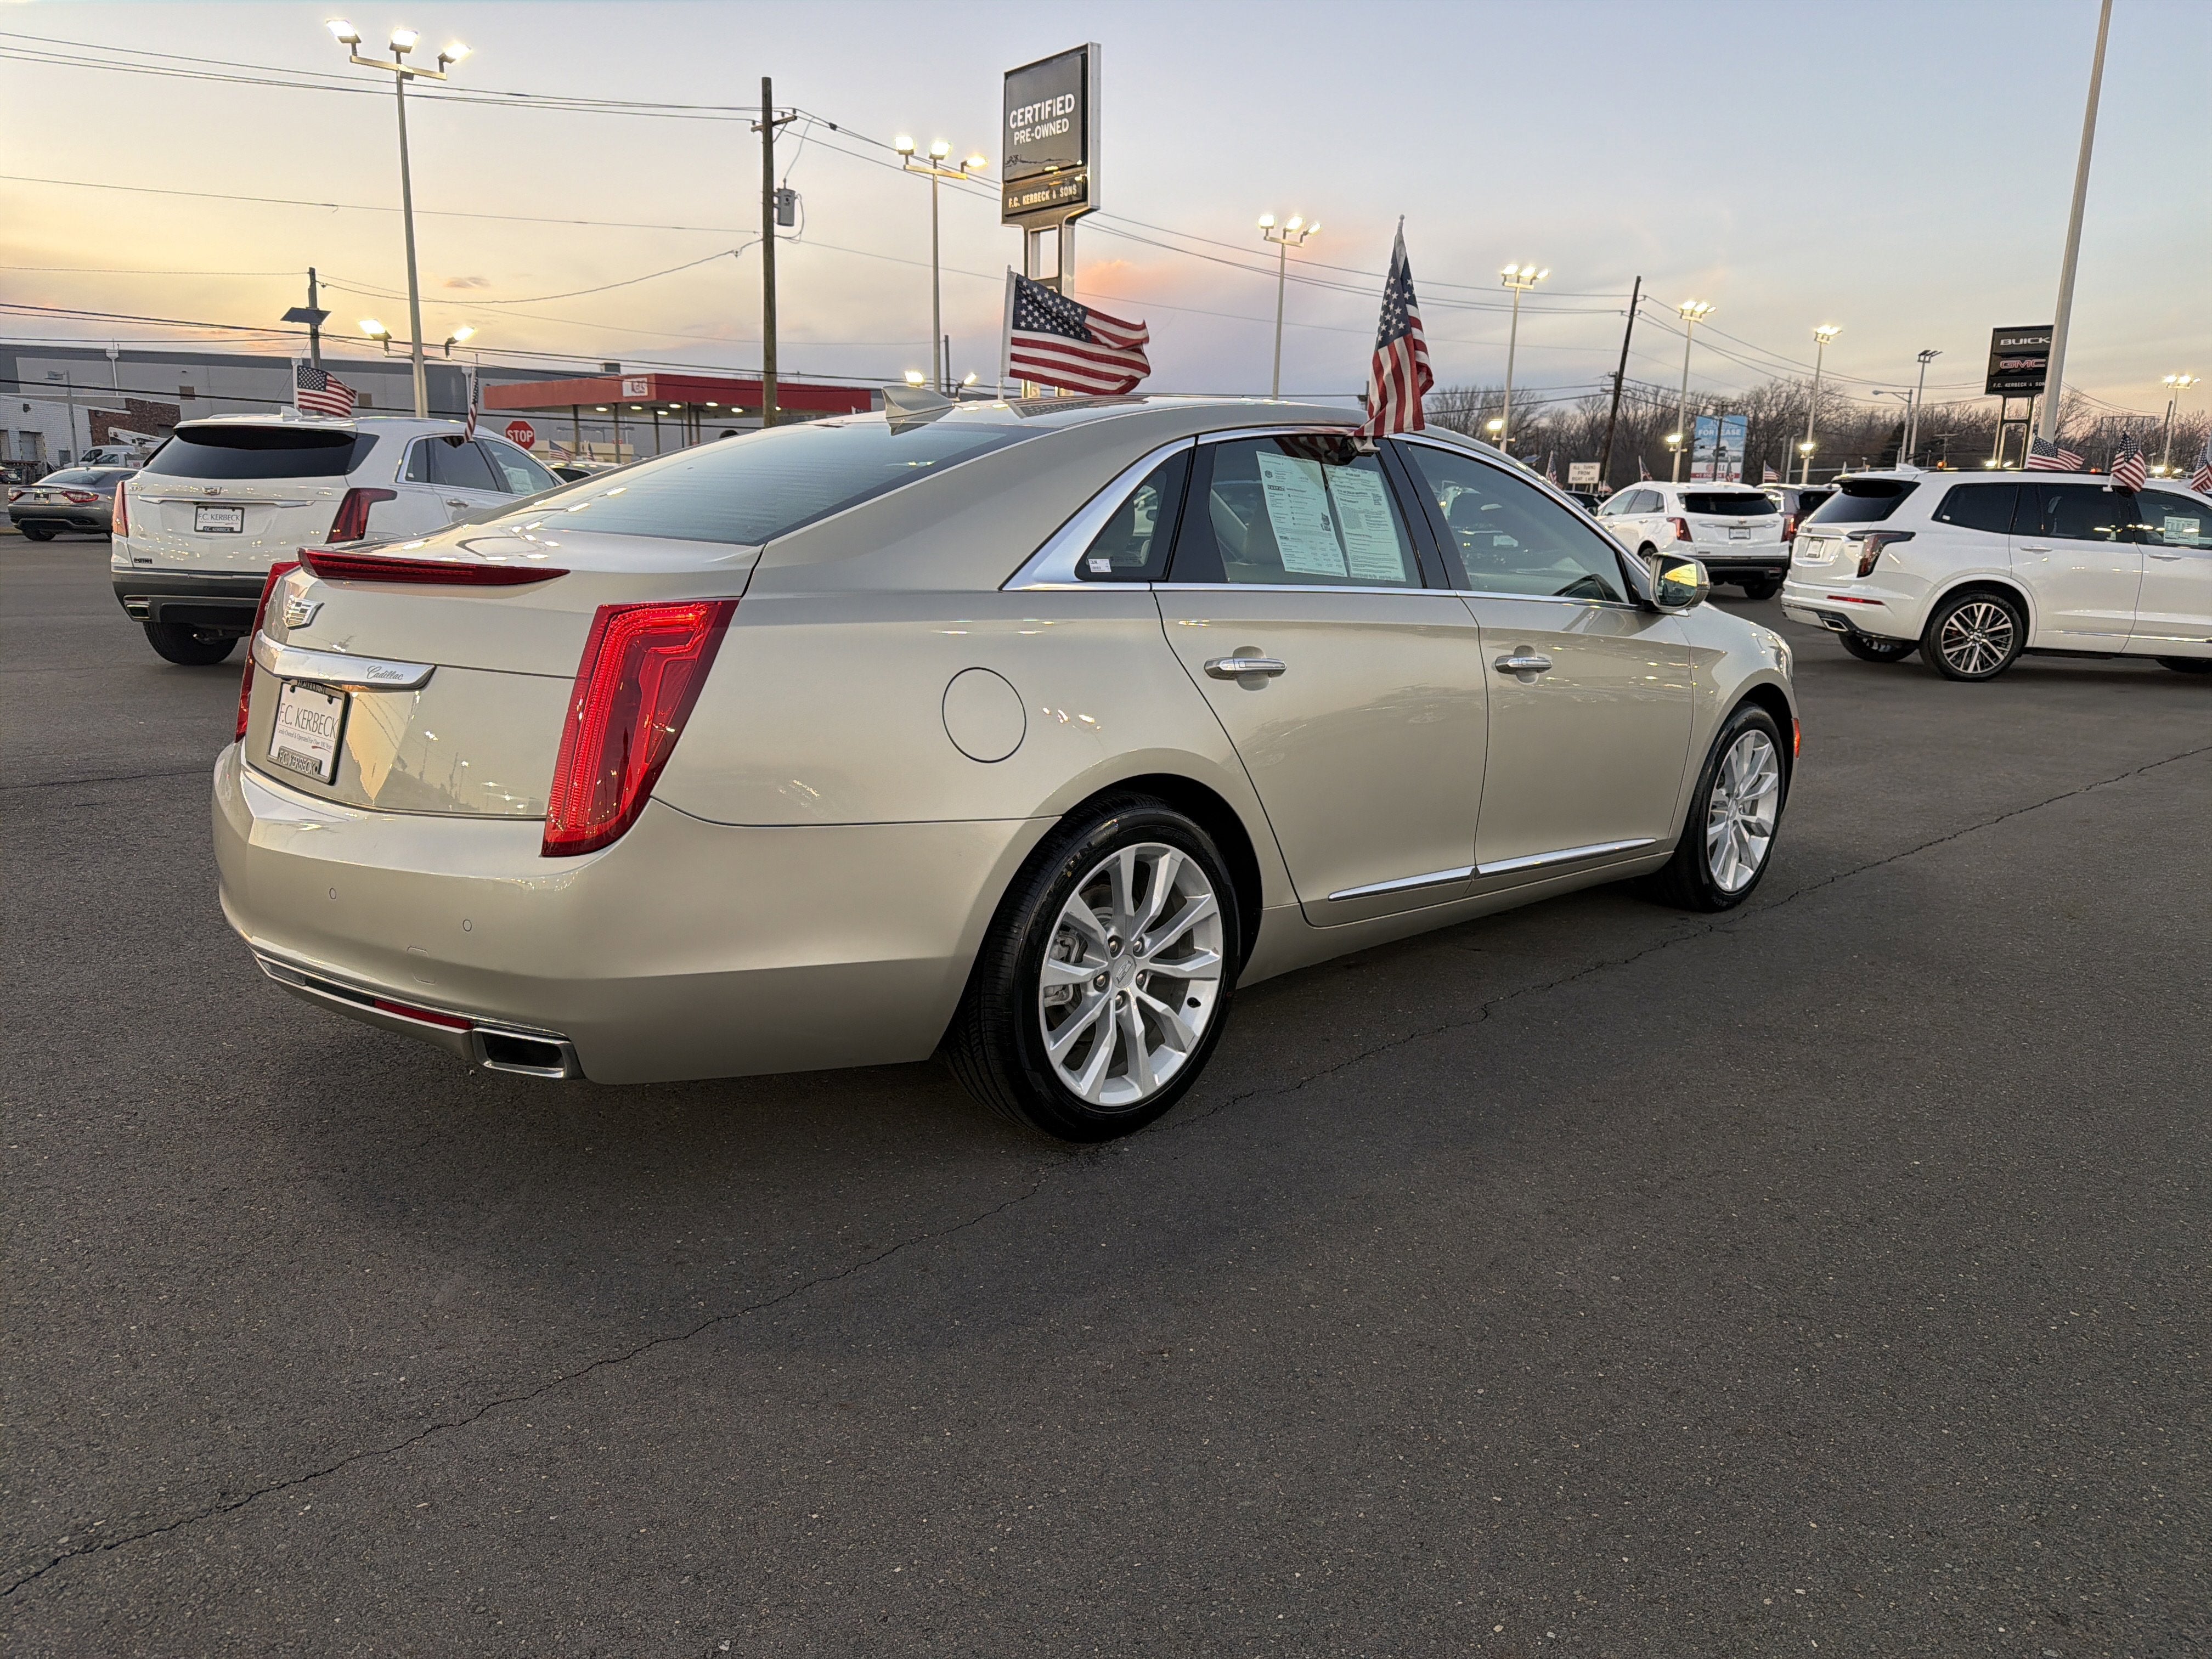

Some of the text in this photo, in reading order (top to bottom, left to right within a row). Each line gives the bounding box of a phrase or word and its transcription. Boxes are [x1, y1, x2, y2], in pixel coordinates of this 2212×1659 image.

[1009, 94, 1075, 129] CERTIFIED
[1014, 118, 1069, 145] PRE-OWNED
[1008, 196, 1020, 208] F.C.
[1022, 190, 1050, 205] KERBECK
[1059, 184, 1077, 198] SONS
[2000, 337, 2051, 346] BUICK
[2000, 359, 2046, 369] GMC
[507, 430, 533, 442] STOP
[366, 665, 404, 680] Cadillac
[278, 703, 339, 739] F.C. KERBECK
[289, 753, 316, 775] KERBECK
